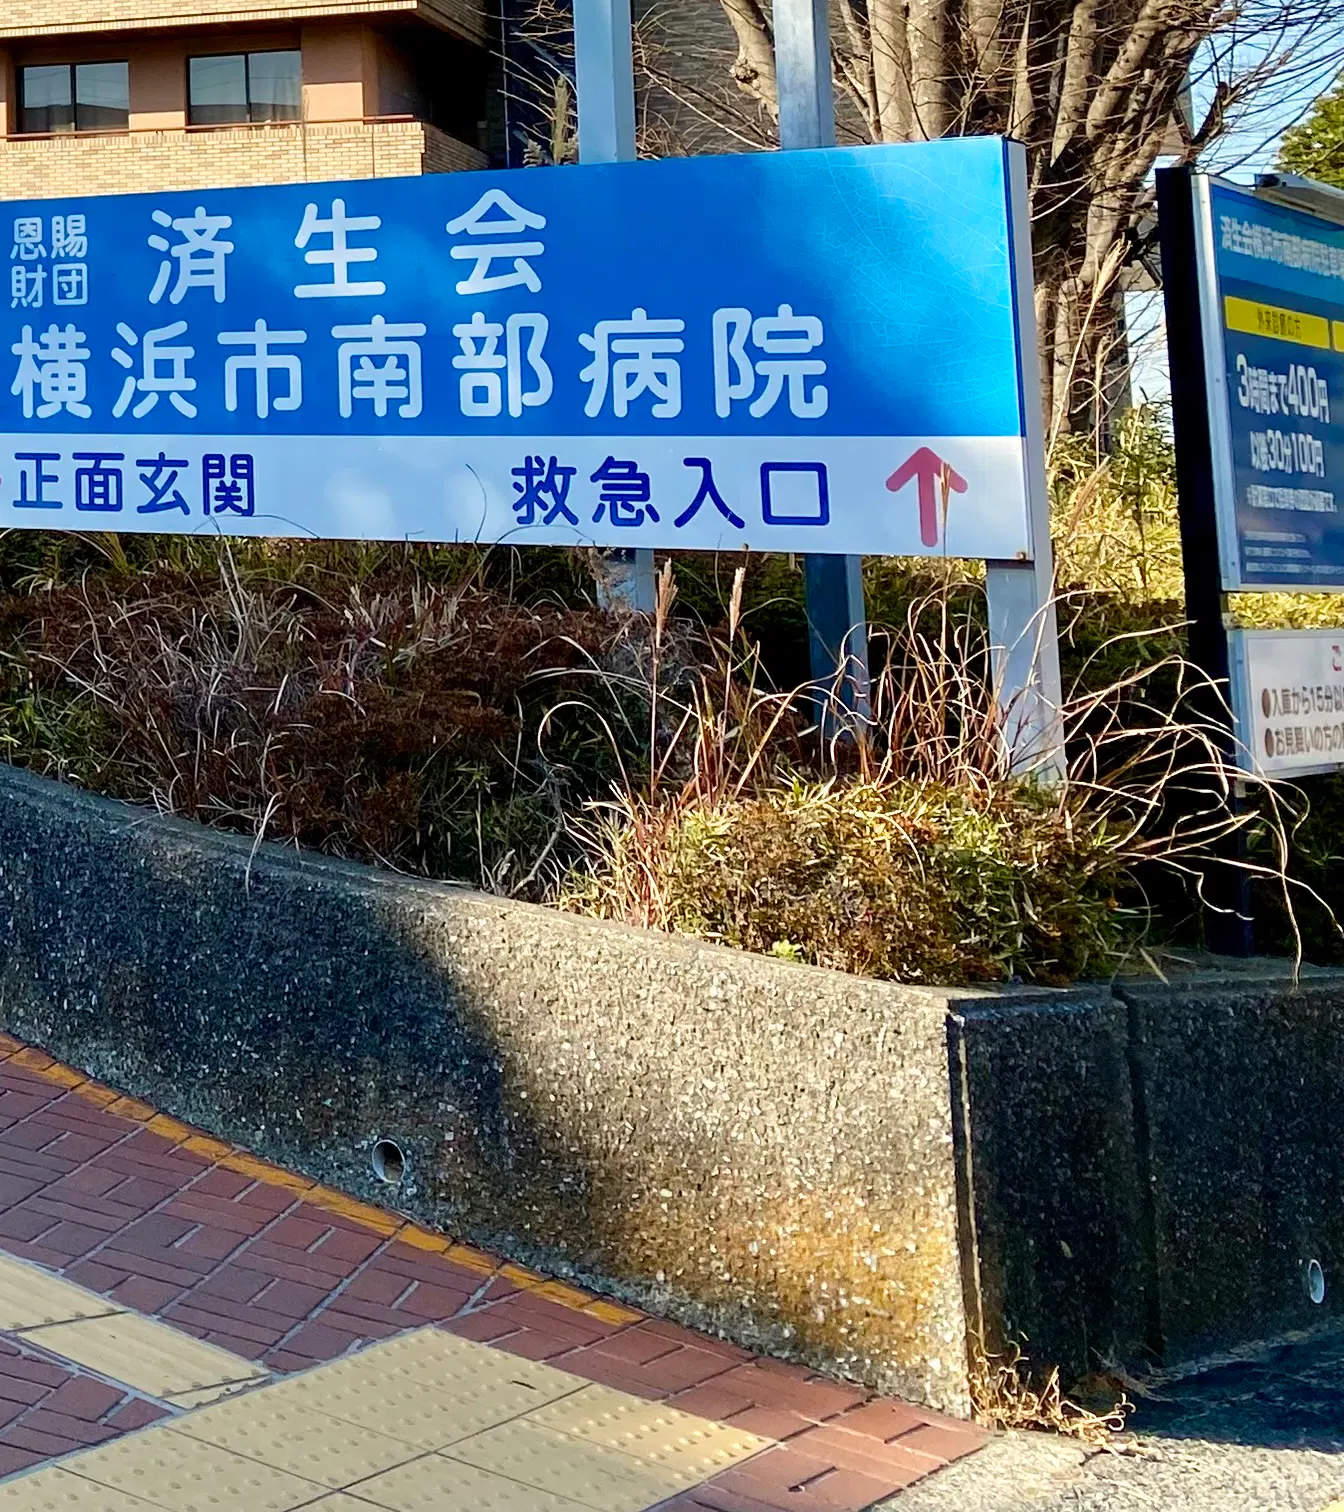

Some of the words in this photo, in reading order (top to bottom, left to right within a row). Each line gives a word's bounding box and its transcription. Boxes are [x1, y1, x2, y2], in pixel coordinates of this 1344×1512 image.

[10, 214, 88, 261] 恩賜
[147, 188, 548, 306] 済生会
[11, 263, 88, 308] 財団
[9, 301, 830, 420] 横浜市南部病院
[12, 451, 256, 518] 正面玄関
[511, 454, 830, 528] 救急入口
